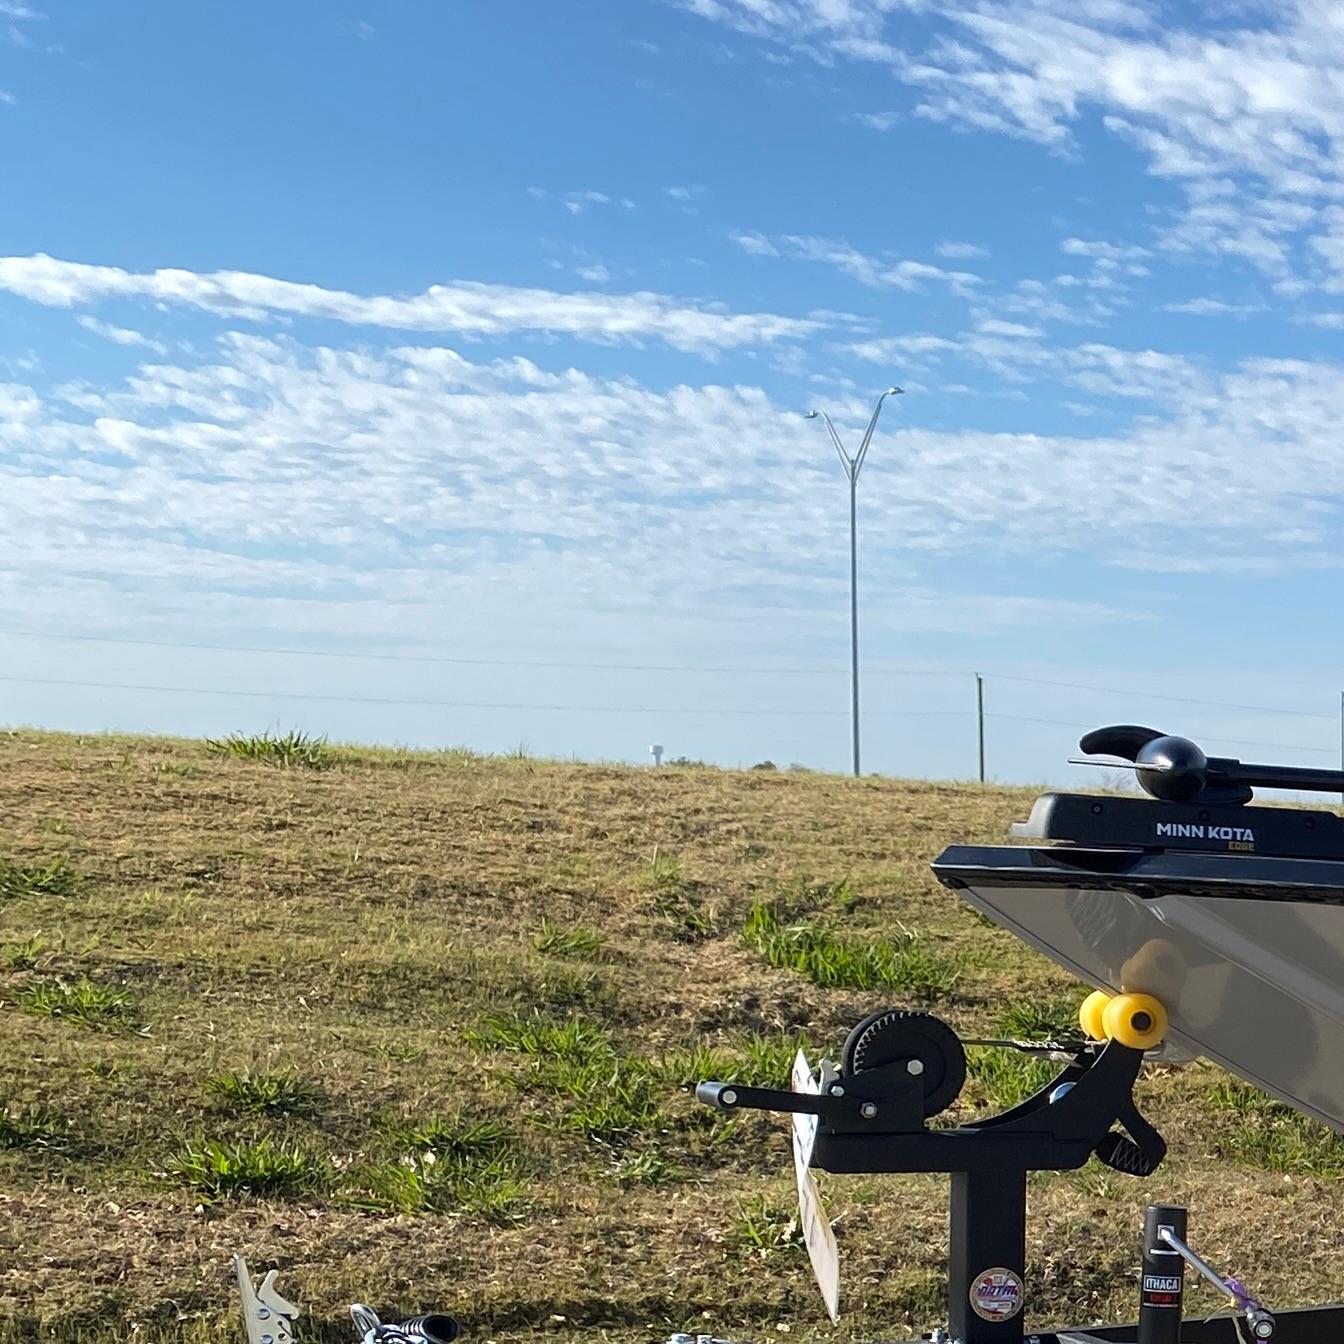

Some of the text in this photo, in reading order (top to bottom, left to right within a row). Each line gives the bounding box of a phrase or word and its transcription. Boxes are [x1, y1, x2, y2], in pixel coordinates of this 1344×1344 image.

[1156, 823, 1255, 841] MINN KOTA
[1228, 842, 1255, 851] EDGE
[1146, 1278, 1178, 1290] ITHACA
